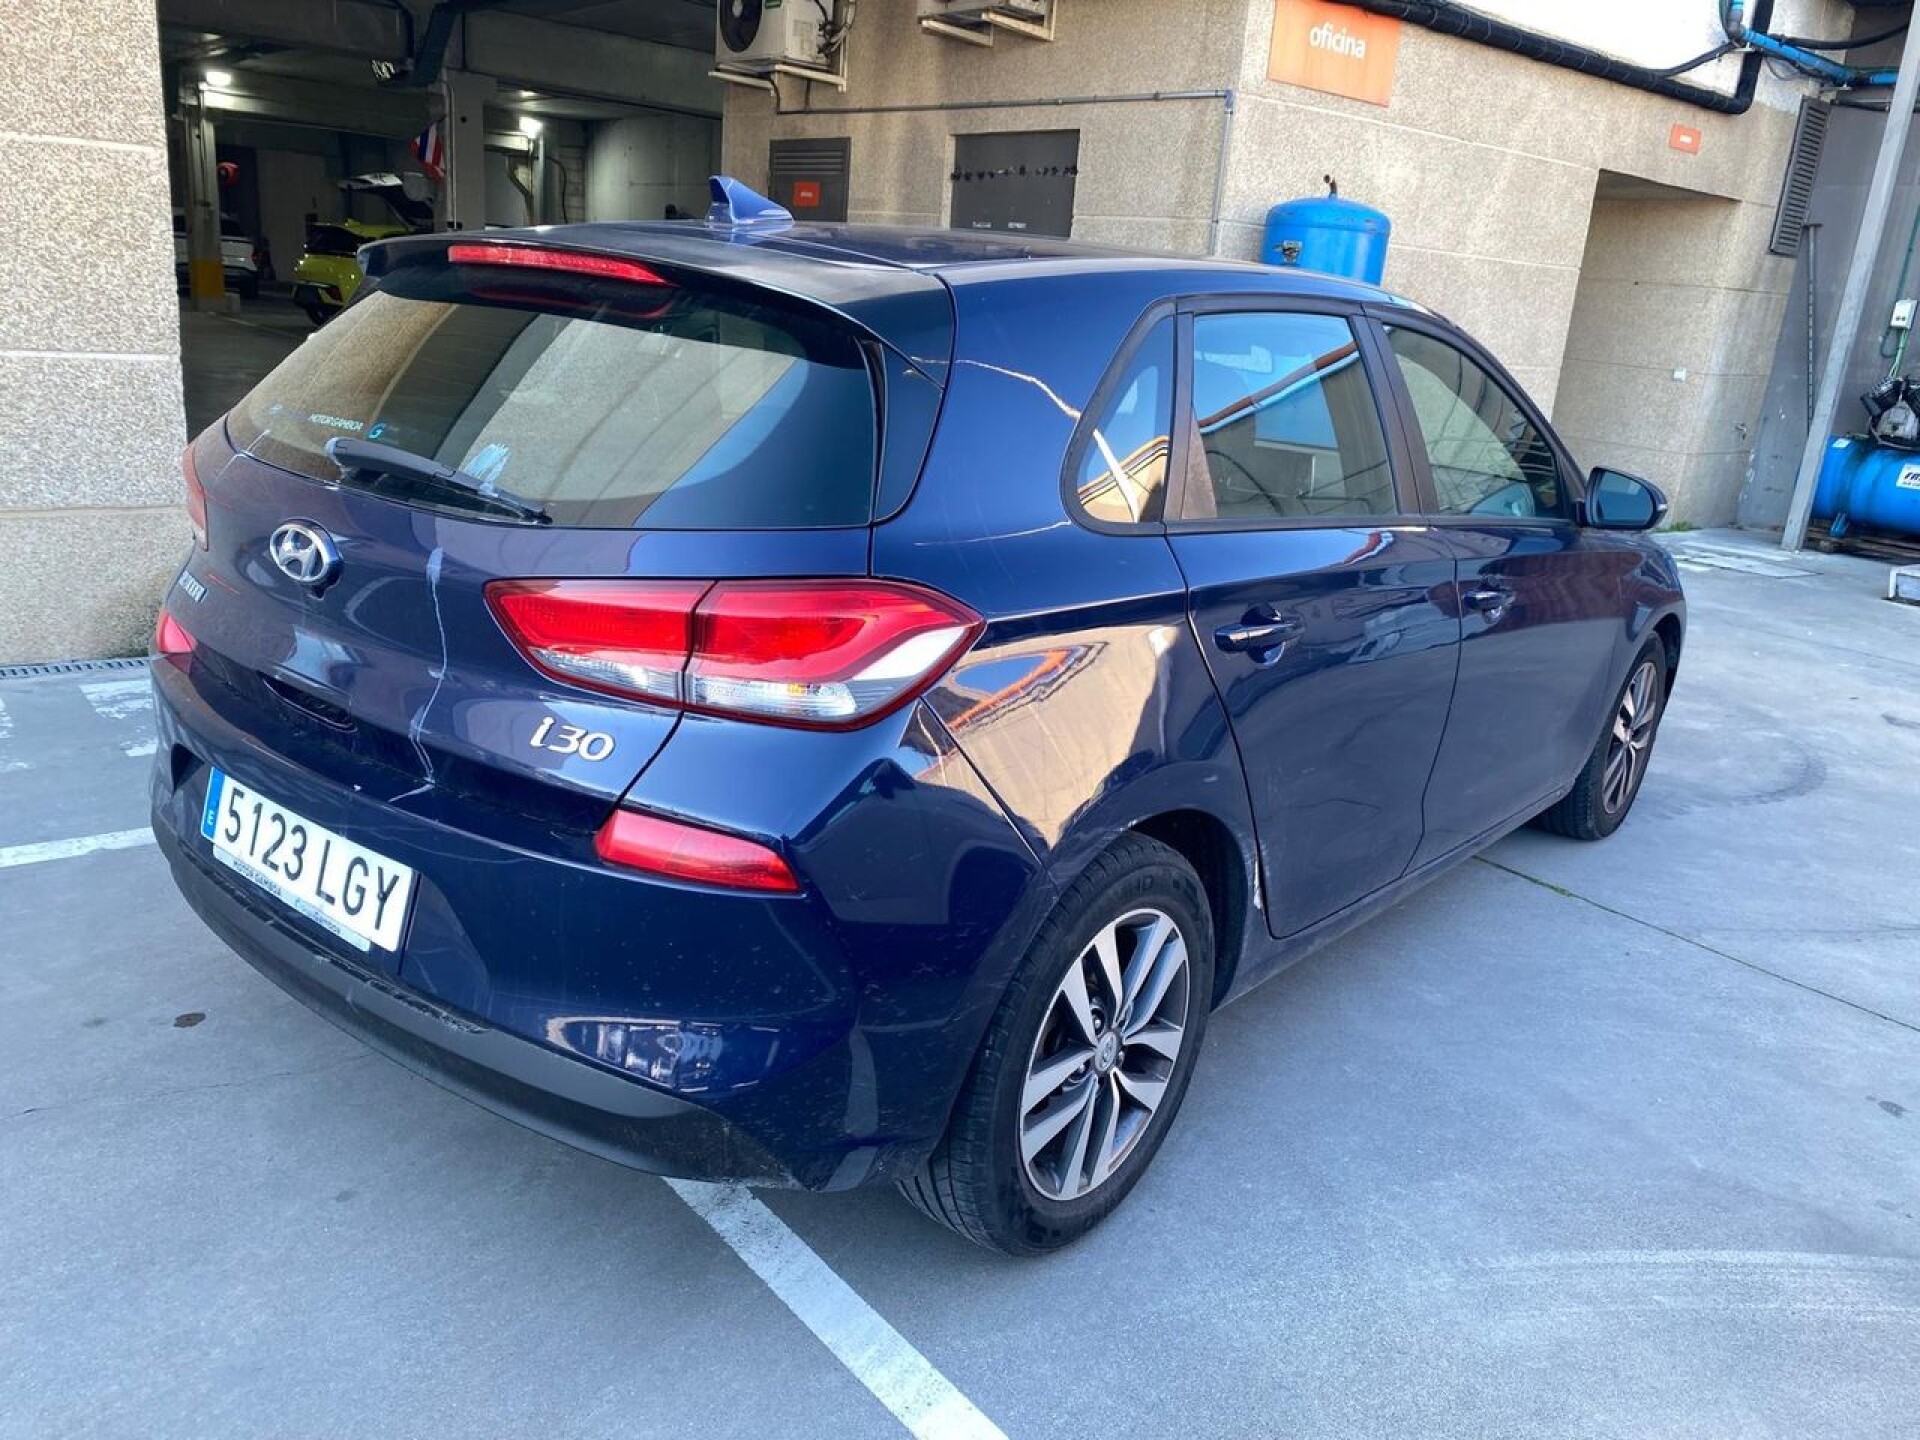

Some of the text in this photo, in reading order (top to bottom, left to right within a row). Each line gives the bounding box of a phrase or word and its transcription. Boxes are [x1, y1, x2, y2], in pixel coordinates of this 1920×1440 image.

[1309, 21, 1366, 59] oficina
[530, 716, 615, 762] i30
[206, 809, 214, 826] E
[224, 787, 400, 931] 5123 LGY
